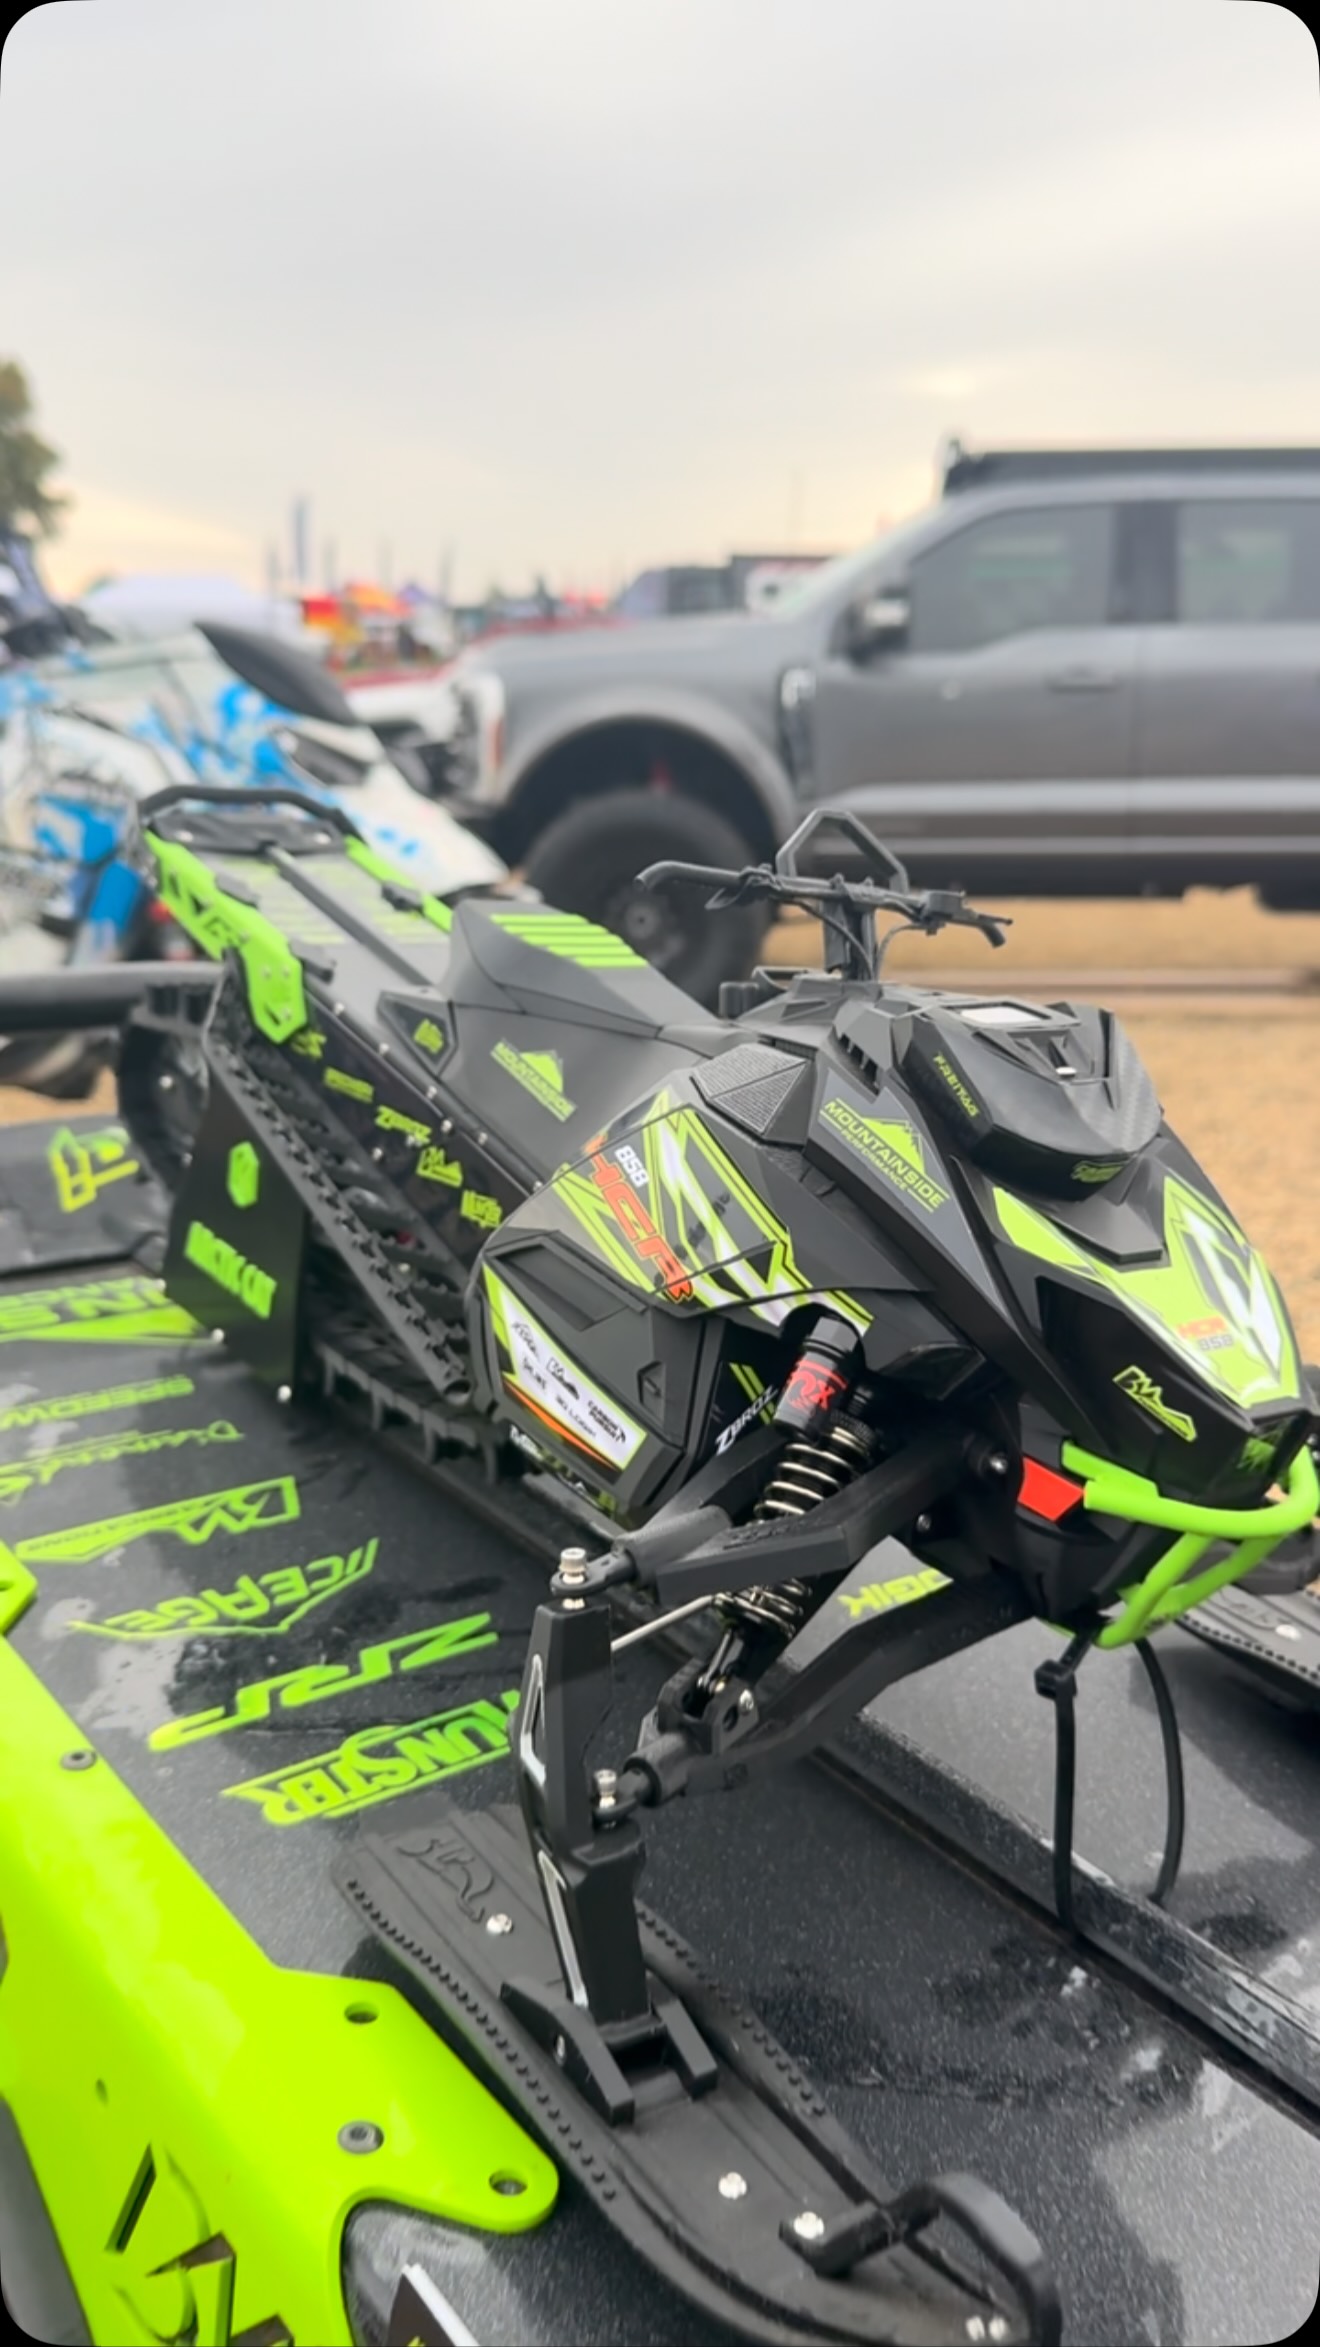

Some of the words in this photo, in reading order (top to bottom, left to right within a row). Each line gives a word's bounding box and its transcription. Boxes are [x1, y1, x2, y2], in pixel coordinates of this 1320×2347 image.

[614, 1145, 649, 1188] 858
[824, 1101, 945, 1208] MOUNTAINSIDE
[841, 1129, 908, 1191] PERFORMANCE
[584, 1133, 694, 1303] HCR
